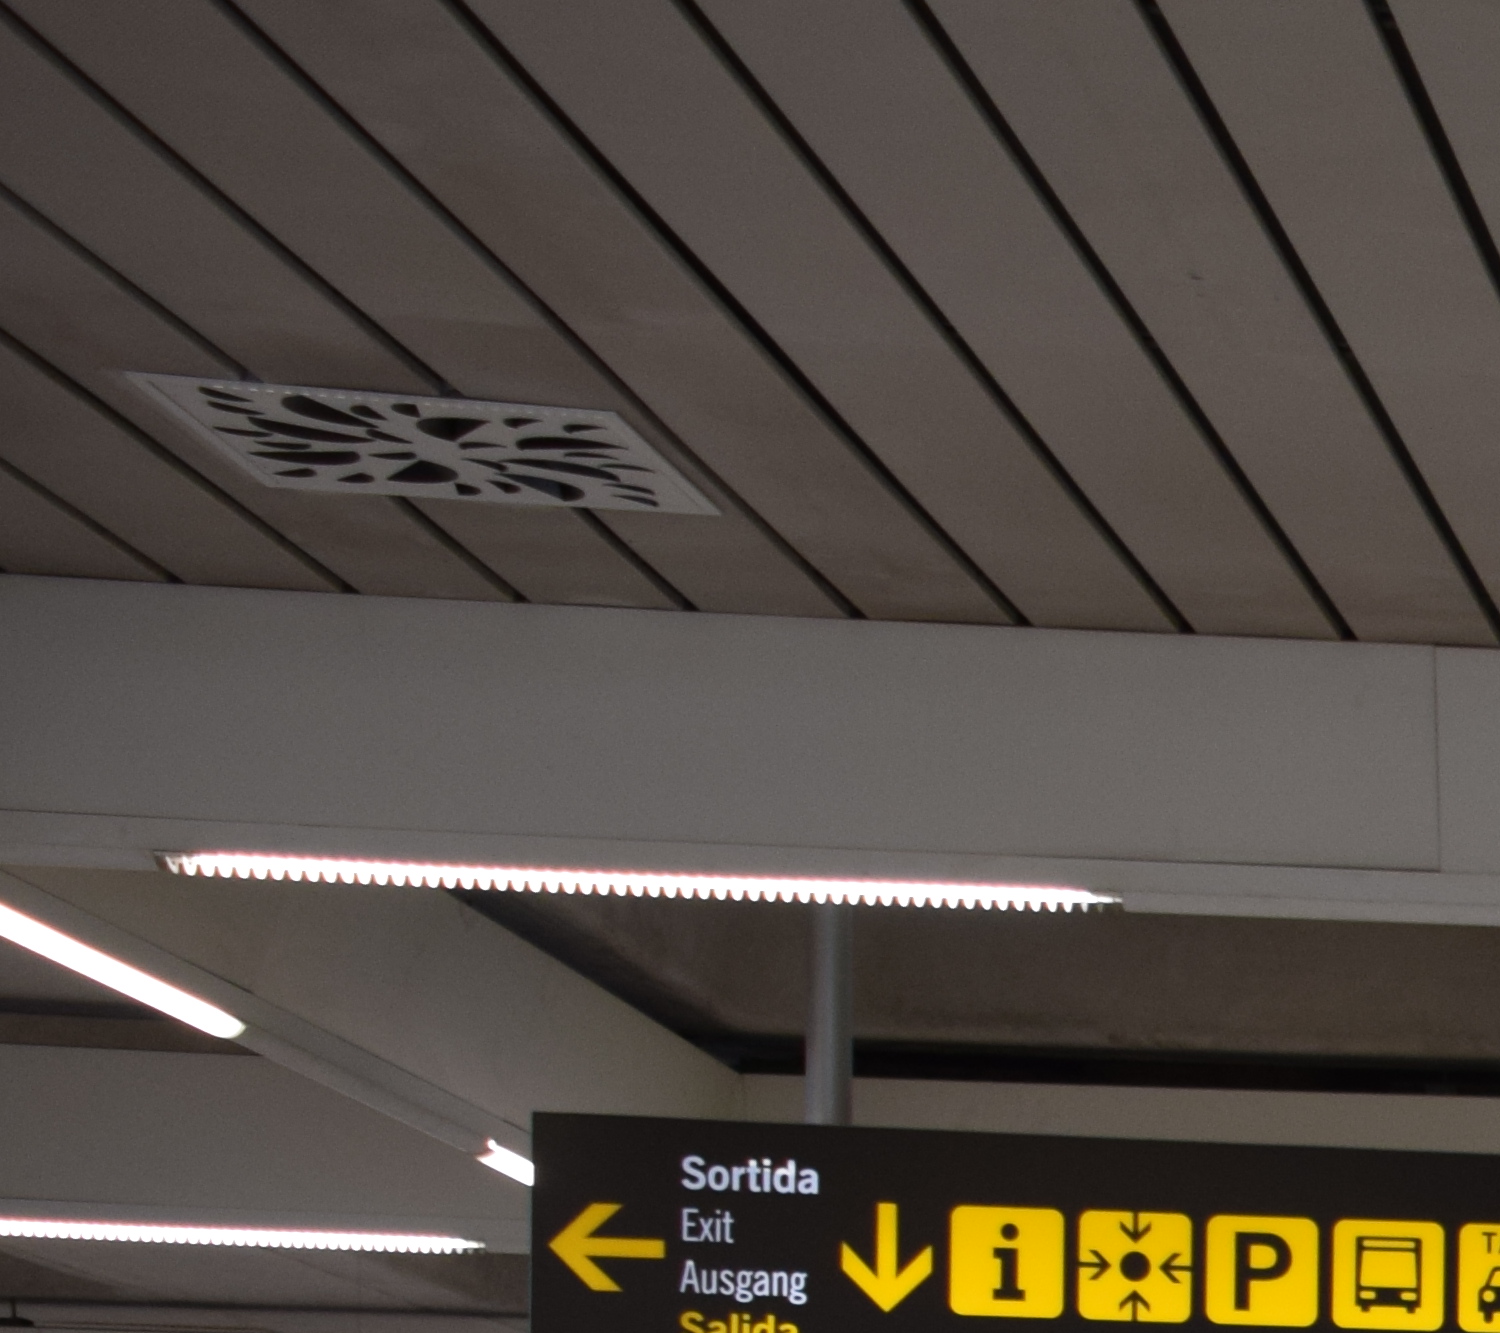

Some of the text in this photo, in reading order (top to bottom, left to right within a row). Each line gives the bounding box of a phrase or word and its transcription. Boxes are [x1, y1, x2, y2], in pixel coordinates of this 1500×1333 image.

[681, 1155, 819, 1195] Sortida
[681, 1207, 735, 1244] Exit
[680, 1259, 808, 1306] Ausgang
